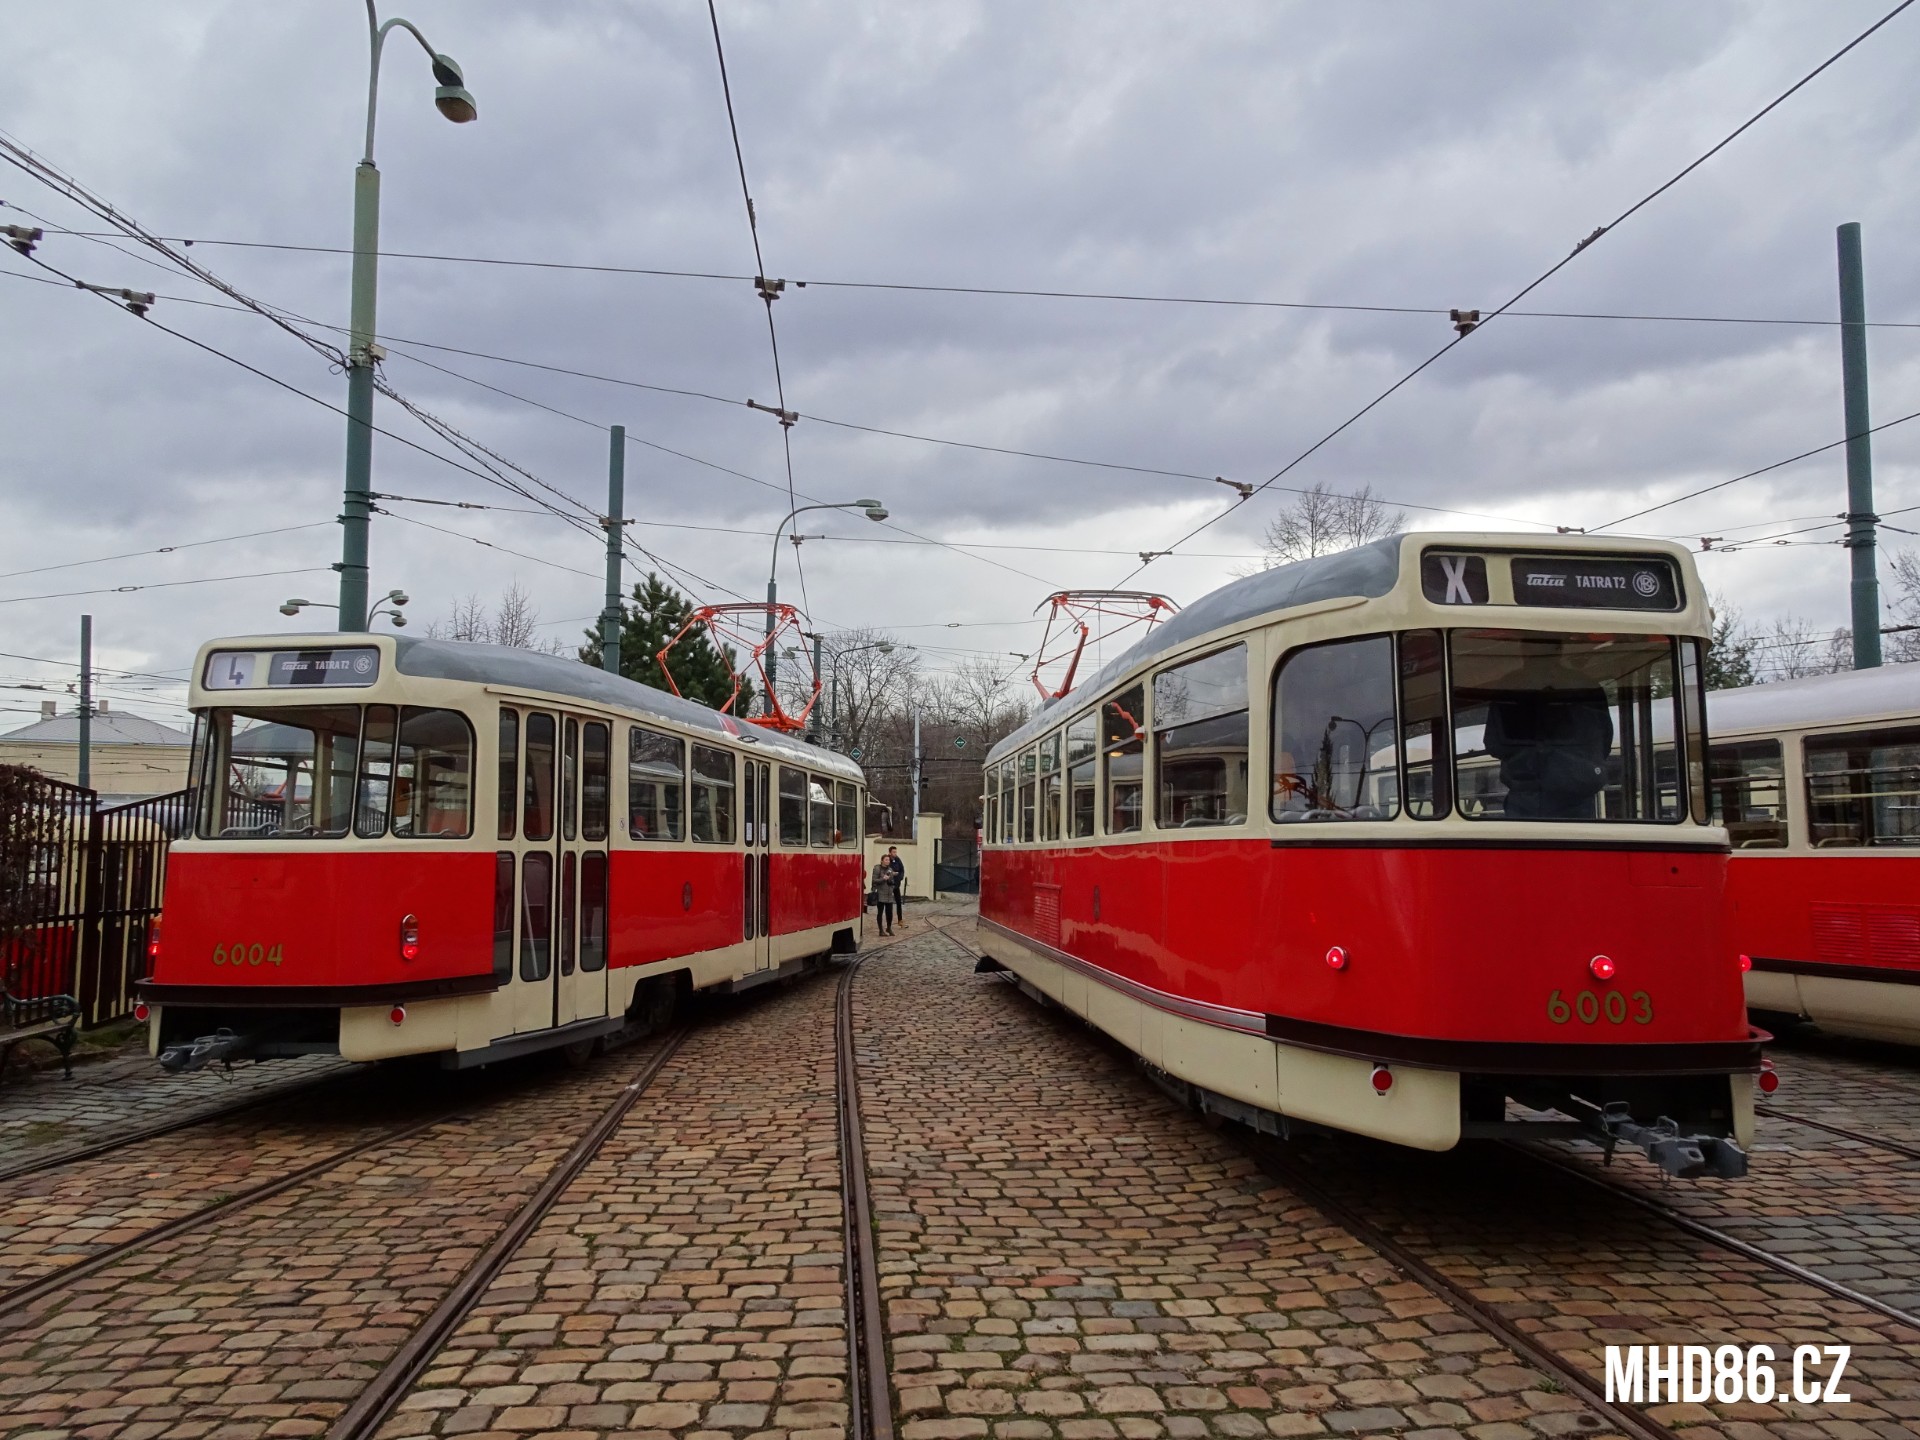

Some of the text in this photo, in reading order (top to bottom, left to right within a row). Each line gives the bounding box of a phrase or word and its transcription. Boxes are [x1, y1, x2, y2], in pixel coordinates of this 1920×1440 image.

[1440, 557, 1473, 604] X
[1575, 575, 1612, 588] TATRA
[1613, 576, 1626, 589] T2
[229, 656, 245, 686] 4
[315, 661, 340, 670] TATRA
[213, 943, 283, 966] 6004
[1547, 990, 1653, 1024] 6003
